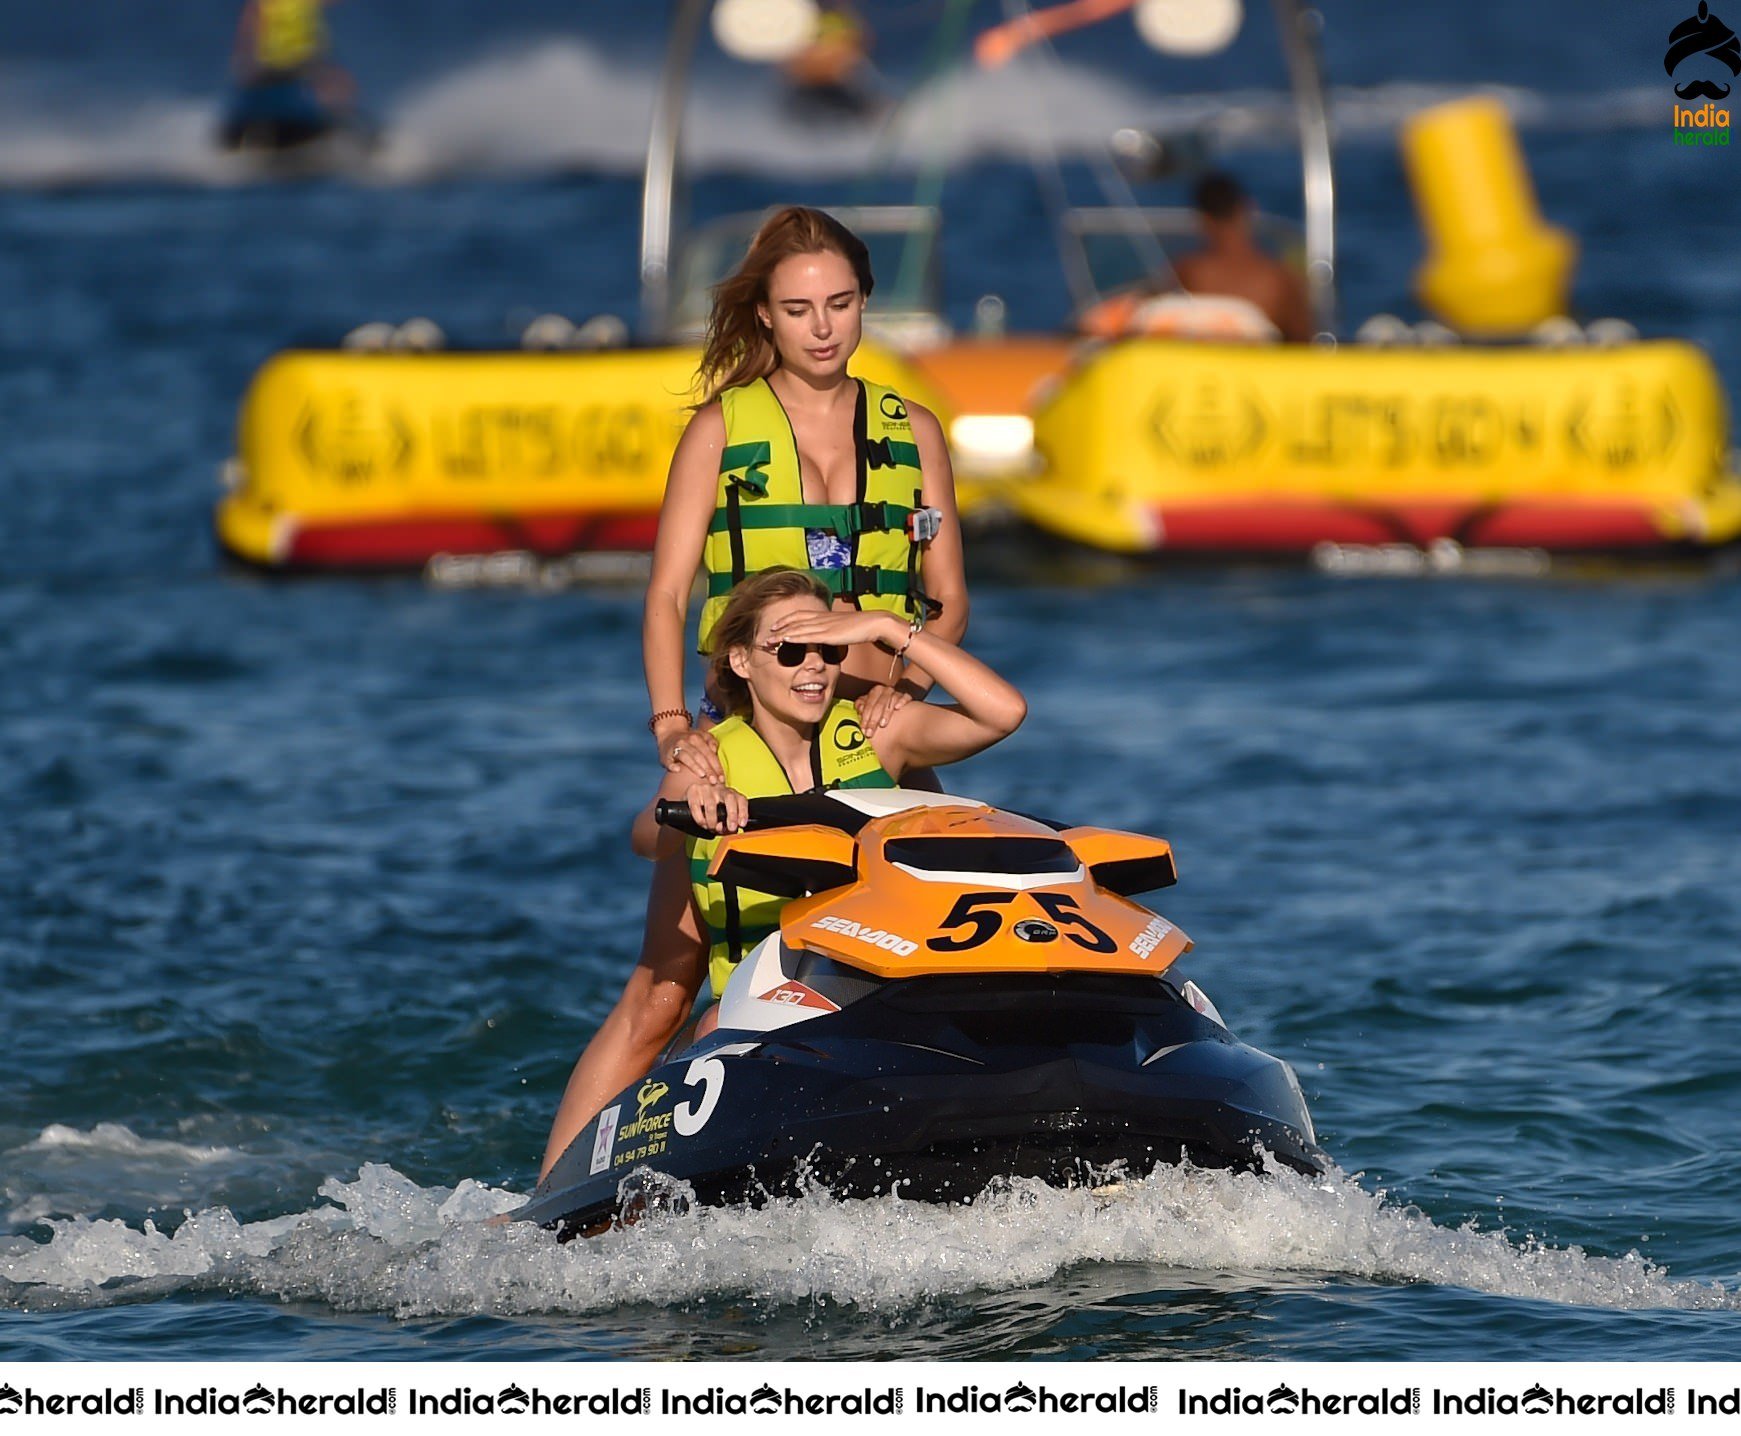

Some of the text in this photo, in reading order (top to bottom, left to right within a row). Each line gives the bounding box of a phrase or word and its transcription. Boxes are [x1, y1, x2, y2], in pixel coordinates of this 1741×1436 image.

[926, 892, 1019, 952] 5
[1028, 892, 1118, 953] 5
[770, 989, 806, 1006] 130
